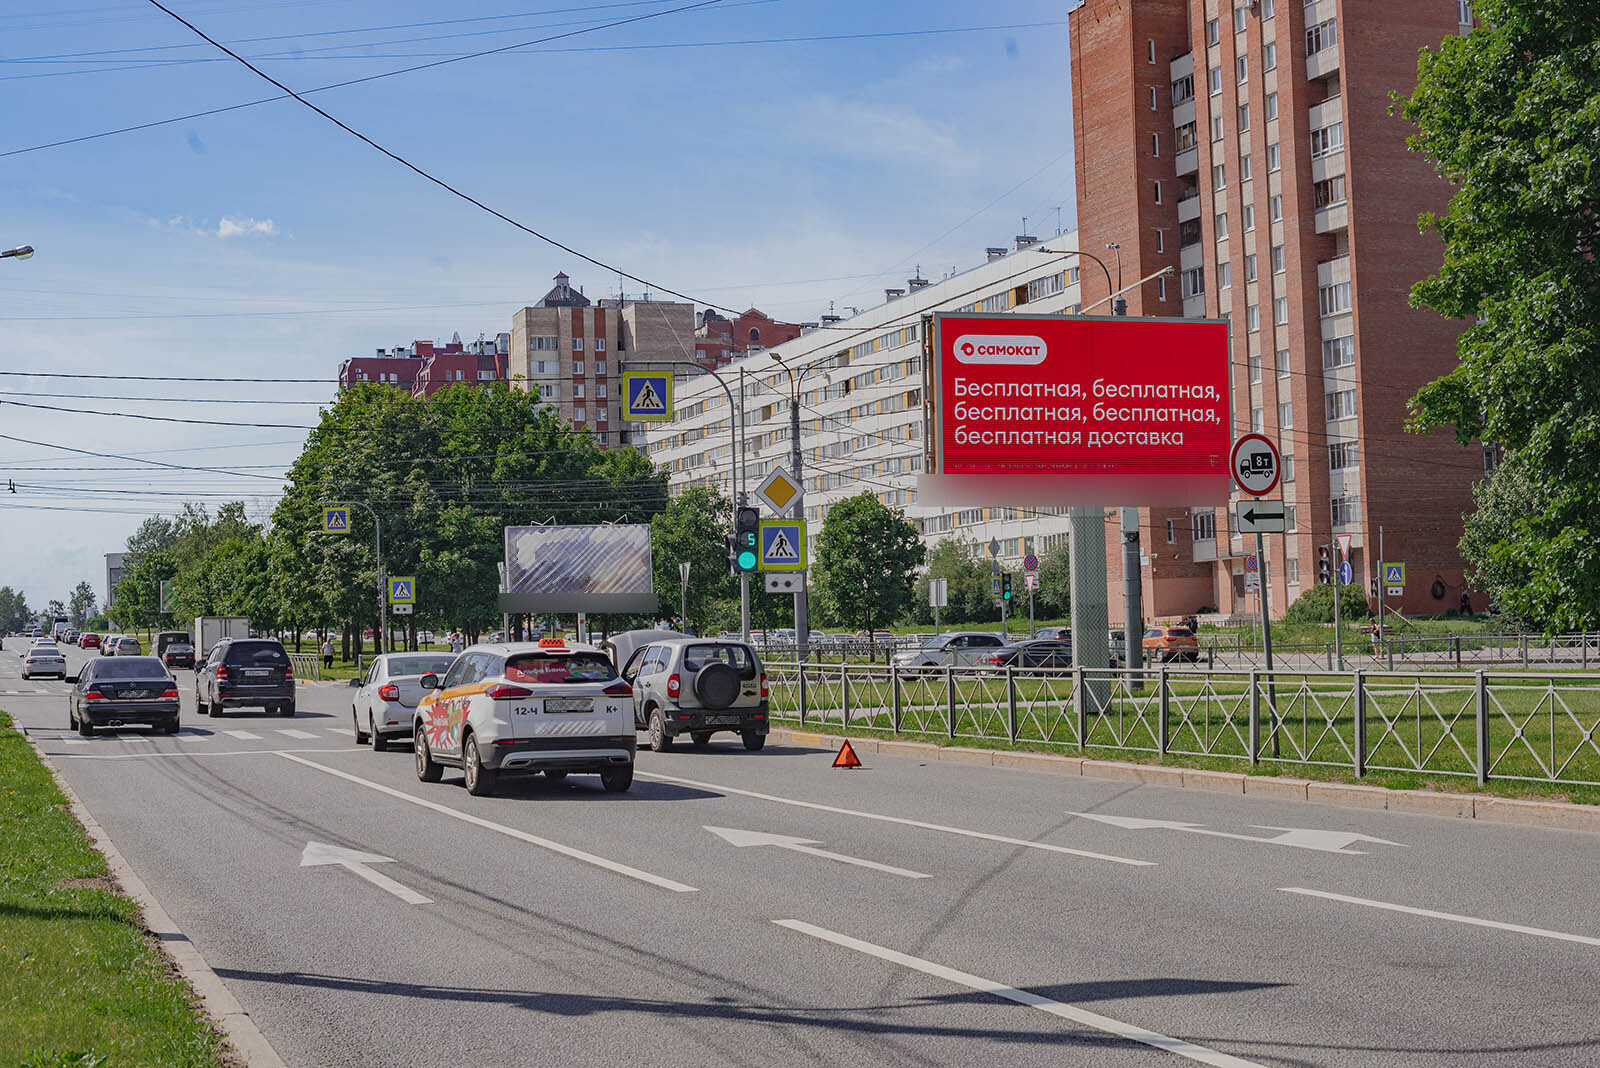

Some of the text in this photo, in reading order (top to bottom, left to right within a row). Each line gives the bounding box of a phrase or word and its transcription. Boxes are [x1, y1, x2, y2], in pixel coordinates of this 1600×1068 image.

[977, 344, 1041, 356] самокат
[953, 378, 1221, 404] Бесплатная, бесплатная,
[953, 401, 1221, 427] бесплатная, бесплатная,
[953, 426, 1184, 448] бесплатная доставка
[748, 533, 755, 546] 5
